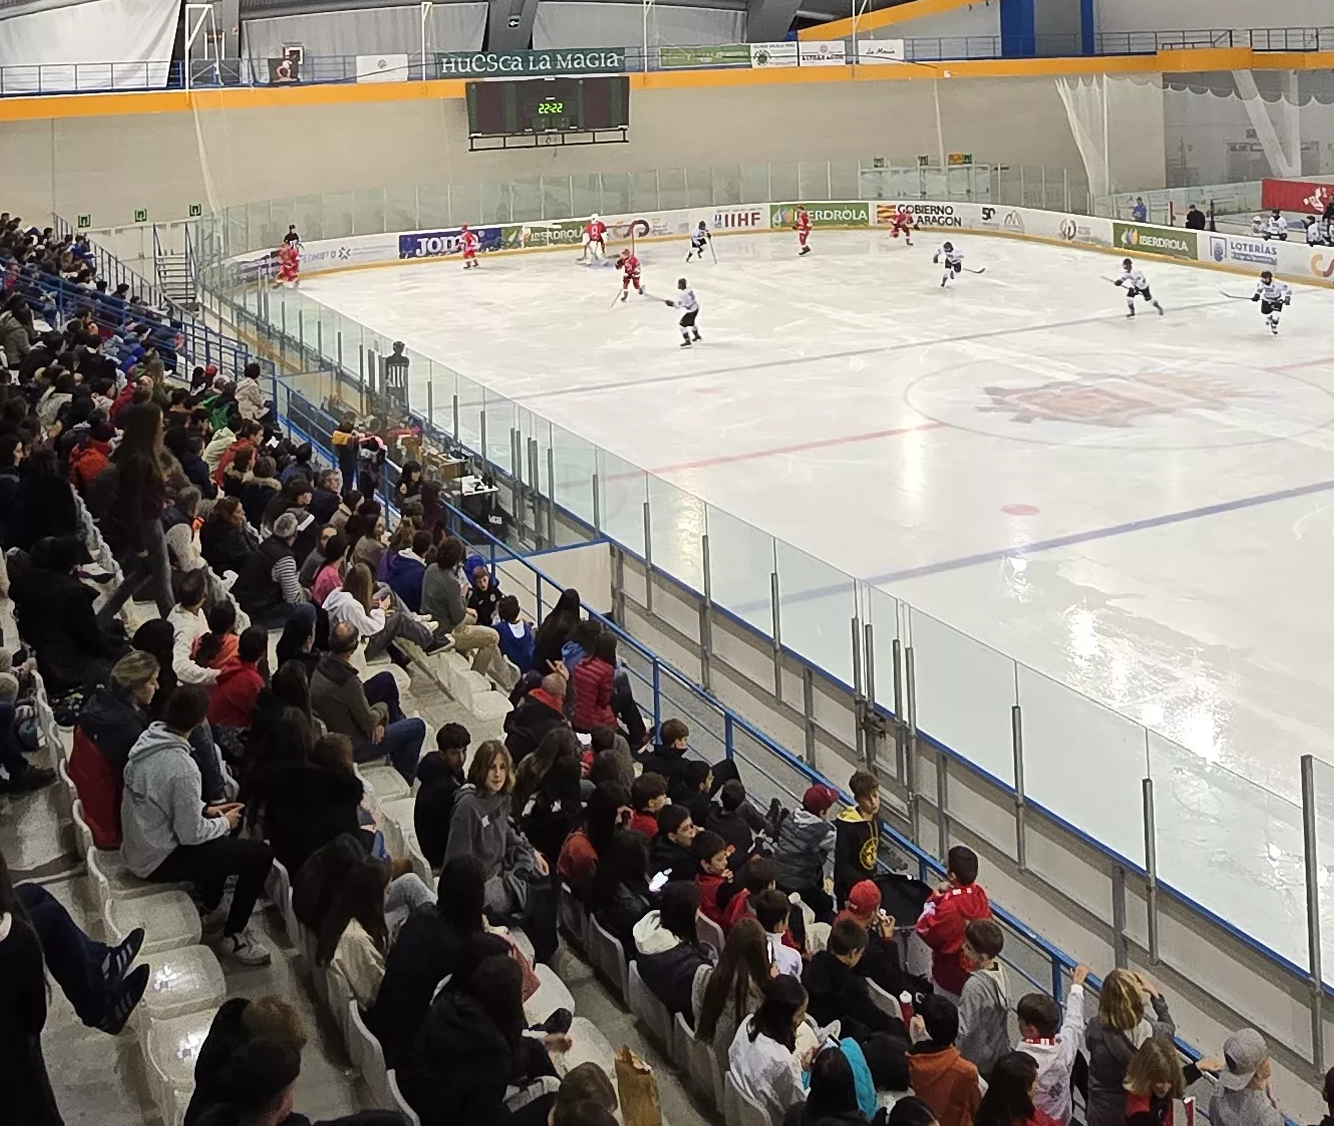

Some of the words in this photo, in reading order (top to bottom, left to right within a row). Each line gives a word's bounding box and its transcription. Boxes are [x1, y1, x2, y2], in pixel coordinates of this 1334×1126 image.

[794, 207, 868, 222] IERDROLA
[897, 204, 954, 216] GOBIERNO
[724, 212, 761, 227] IIHF
[1139, 235, 1189, 252] IBERDROLA
